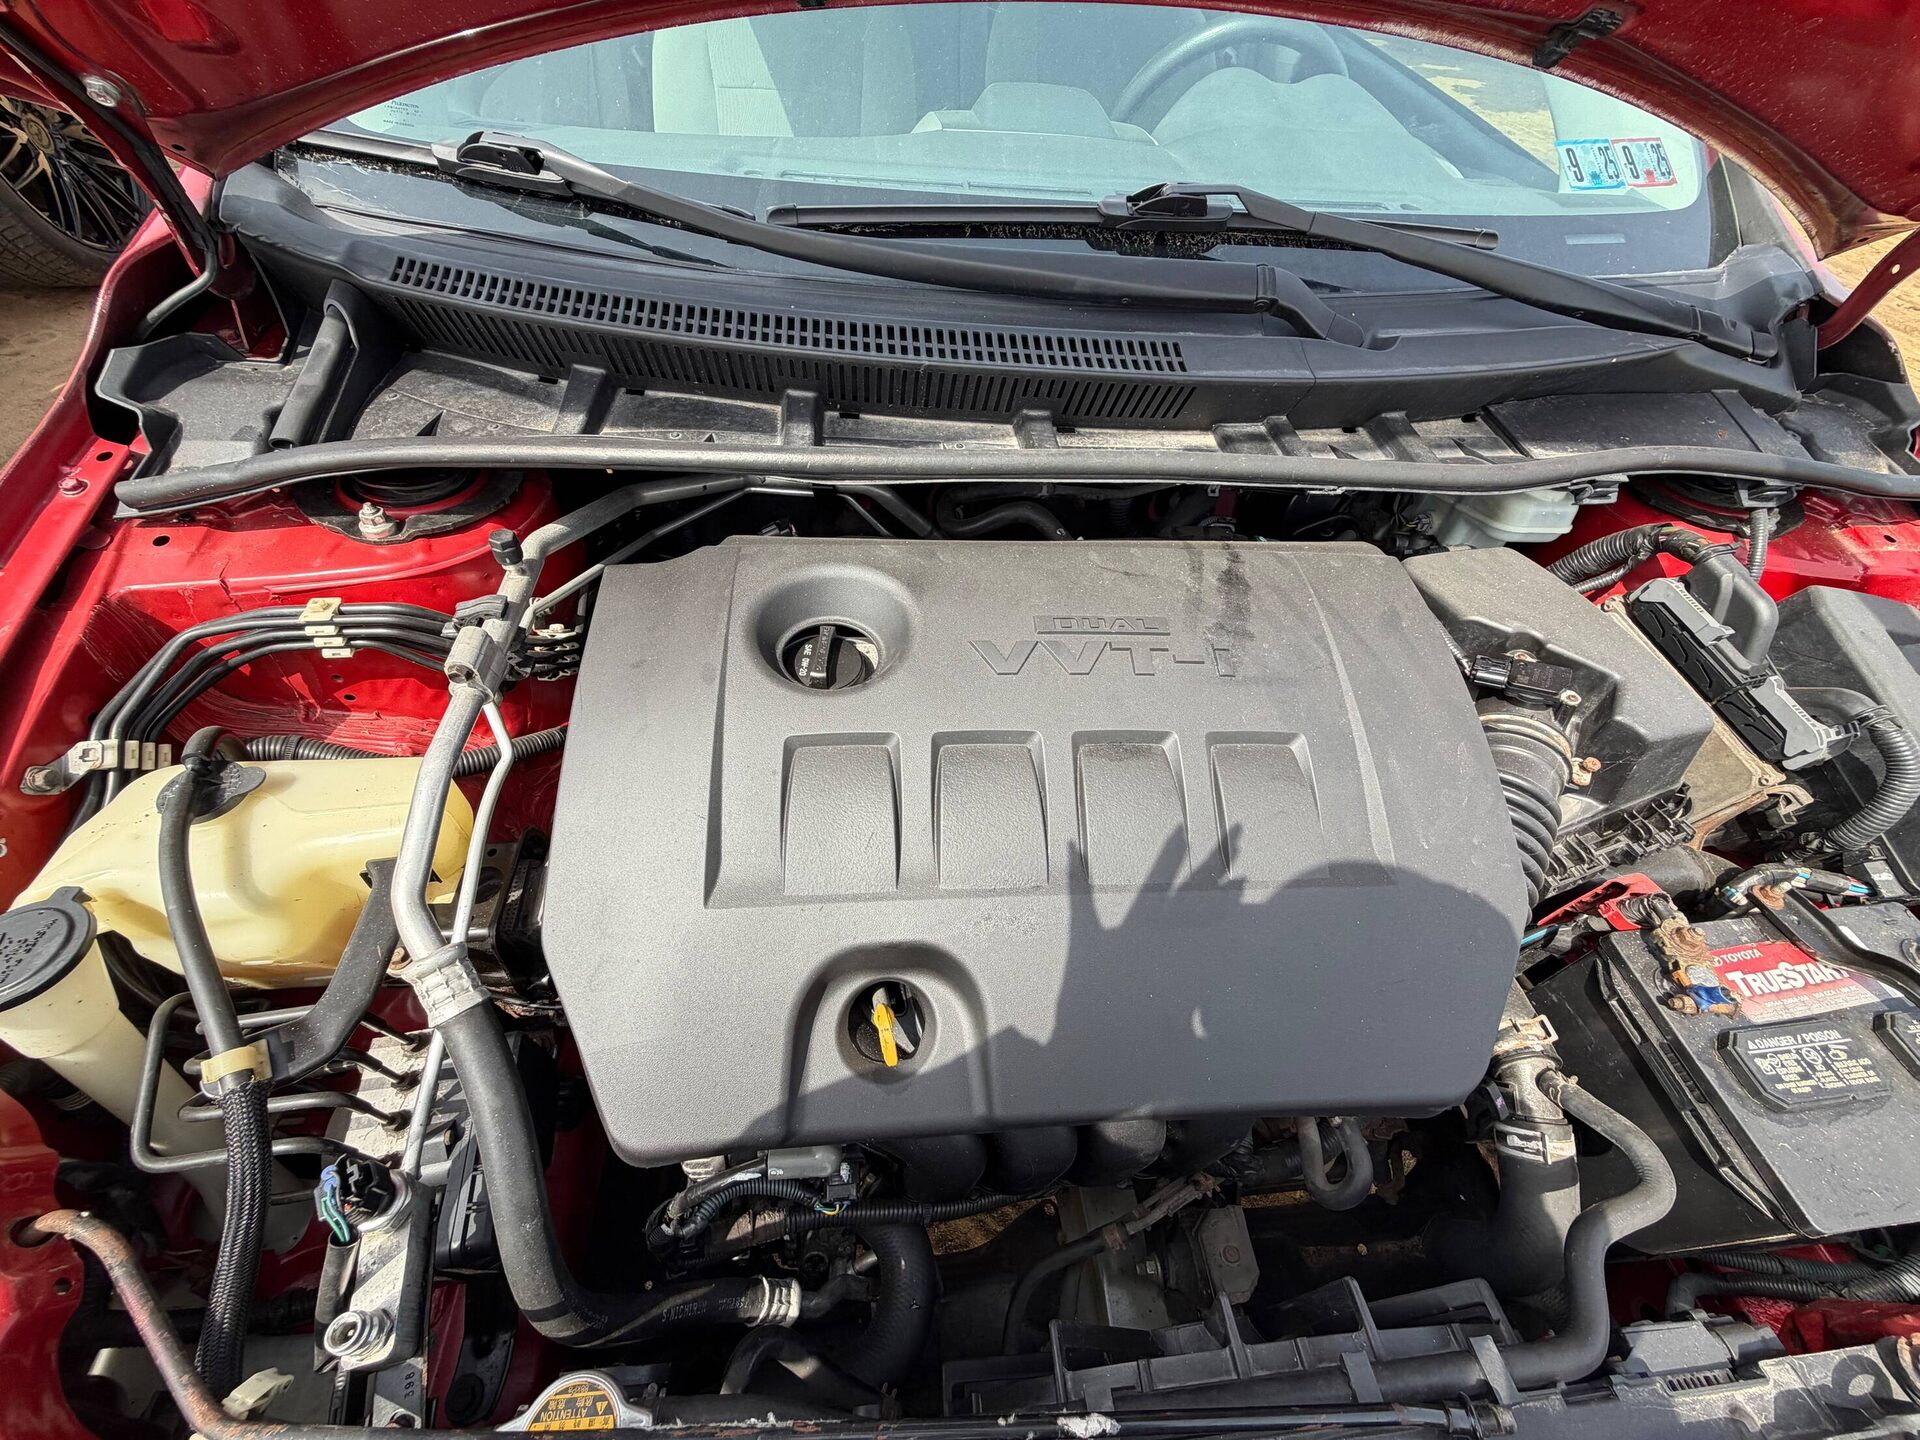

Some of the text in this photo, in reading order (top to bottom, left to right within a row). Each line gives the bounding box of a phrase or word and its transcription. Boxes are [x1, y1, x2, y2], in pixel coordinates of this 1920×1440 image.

[1565, 147, 1585, 183] 9
[1597, 145, 1620, 180] 25
[1621, 145, 1641, 180] 9
[1650, 143, 1672, 177] 25
[1052, 616, 1159, 630] DUAL
[798, 643, 813, 677] SAE 0W-20
[1721, 948, 1764, 965] TOYOTA
[1755, 1035, 1798, 1049] DANGER
[1801, 1030, 1842, 1044] POISON
[540, 1407, 588, 1422] ATTENTION
